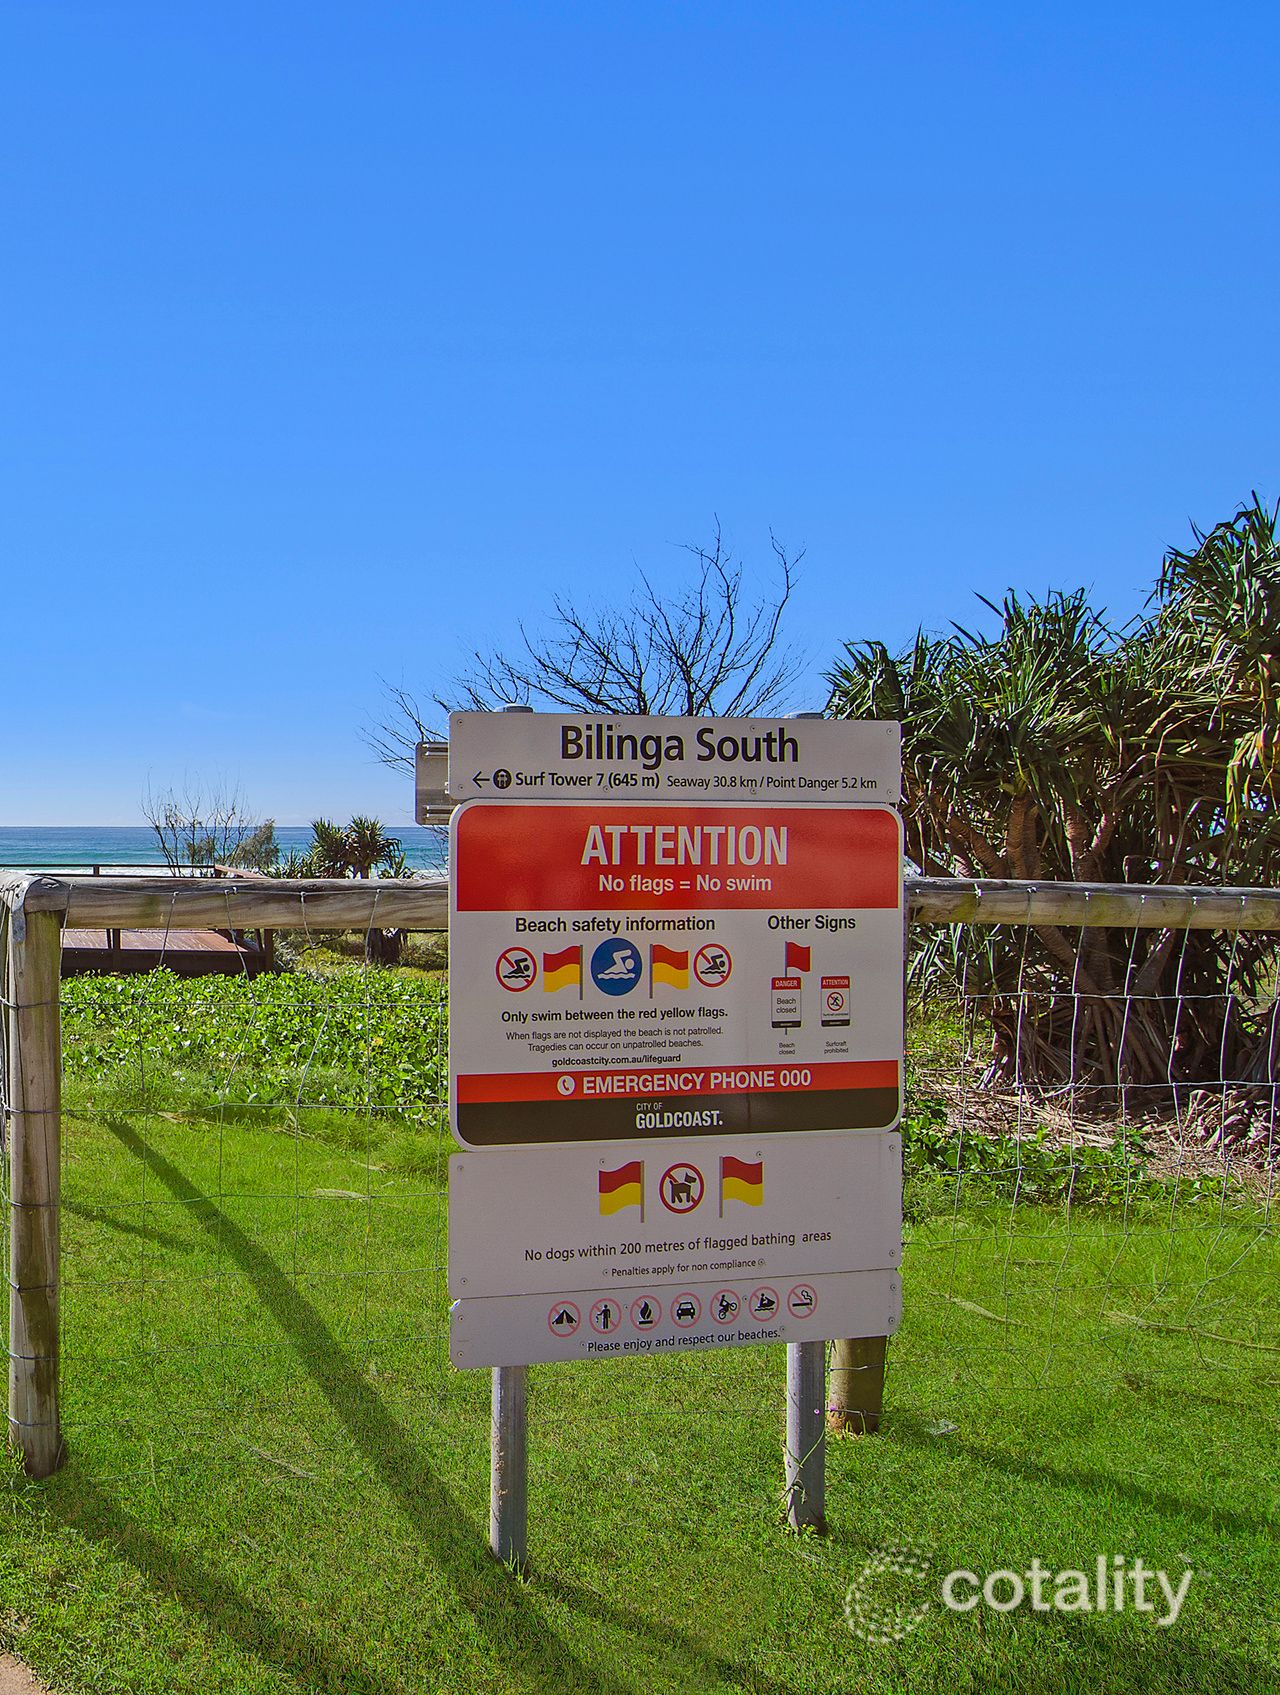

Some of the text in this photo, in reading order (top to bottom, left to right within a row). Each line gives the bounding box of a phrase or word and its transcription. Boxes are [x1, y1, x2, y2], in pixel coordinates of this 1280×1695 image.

[561, 724, 799, 770] Bilinga South
[515, 772, 545, 786] Surf
[549, 773, 592, 786] Tower
[596, 773, 604, 786] 7
[608, 773, 638, 789] (645
[642, 773, 660, 789] m)
[667, 776, 710, 790] Seaway
[713, 776, 737, 787] 30.8
[740, 776, 757, 787] km
[767, 777, 795, 788] Point
[798, 777, 839, 791] Danger
[842, 777, 857, 788] 5.2
[860, 777, 877, 788] km
[581, 825, 788, 866] ATTENTION
[599, 874, 624, 892] No
[629, 875, 674, 894] flags
[696, 875, 721, 891] No
[725, 875, 772, 891] swim
[515, 916, 715, 935] Beach safety information
[767, 915, 856, 932] Other Signs
[502, 1007, 728, 1024] Only swim between the red yellow flags.
[506, 1027, 723, 1041] When flags are not displayed the beach is not patrolled.
[528, 1042, 567, 1053] Tragedies
[586, 1042, 608, 1050] occur
[622, 1040, 666, 1050] unpatrolled
[669, 1039, 703, 1048] beaches.
[552, 1054, 681, 1068] goldcoastcity.com.au/lifeguard
[583, 1069, 812, 1094] EMERGENCY PHONE 000
[636, 1102, 663, 1111] CITY OF
[635, 1111, 723, 1129] GOLDCOAST.
[525, 1232, 832, 1261] No dogs within 200 metres of flagged bathing areas
[611, 1259, 756, 1276] Penalties apply for non compliance
[588, 1329, 781, 1352] Please enjoy and respect our beaches.
